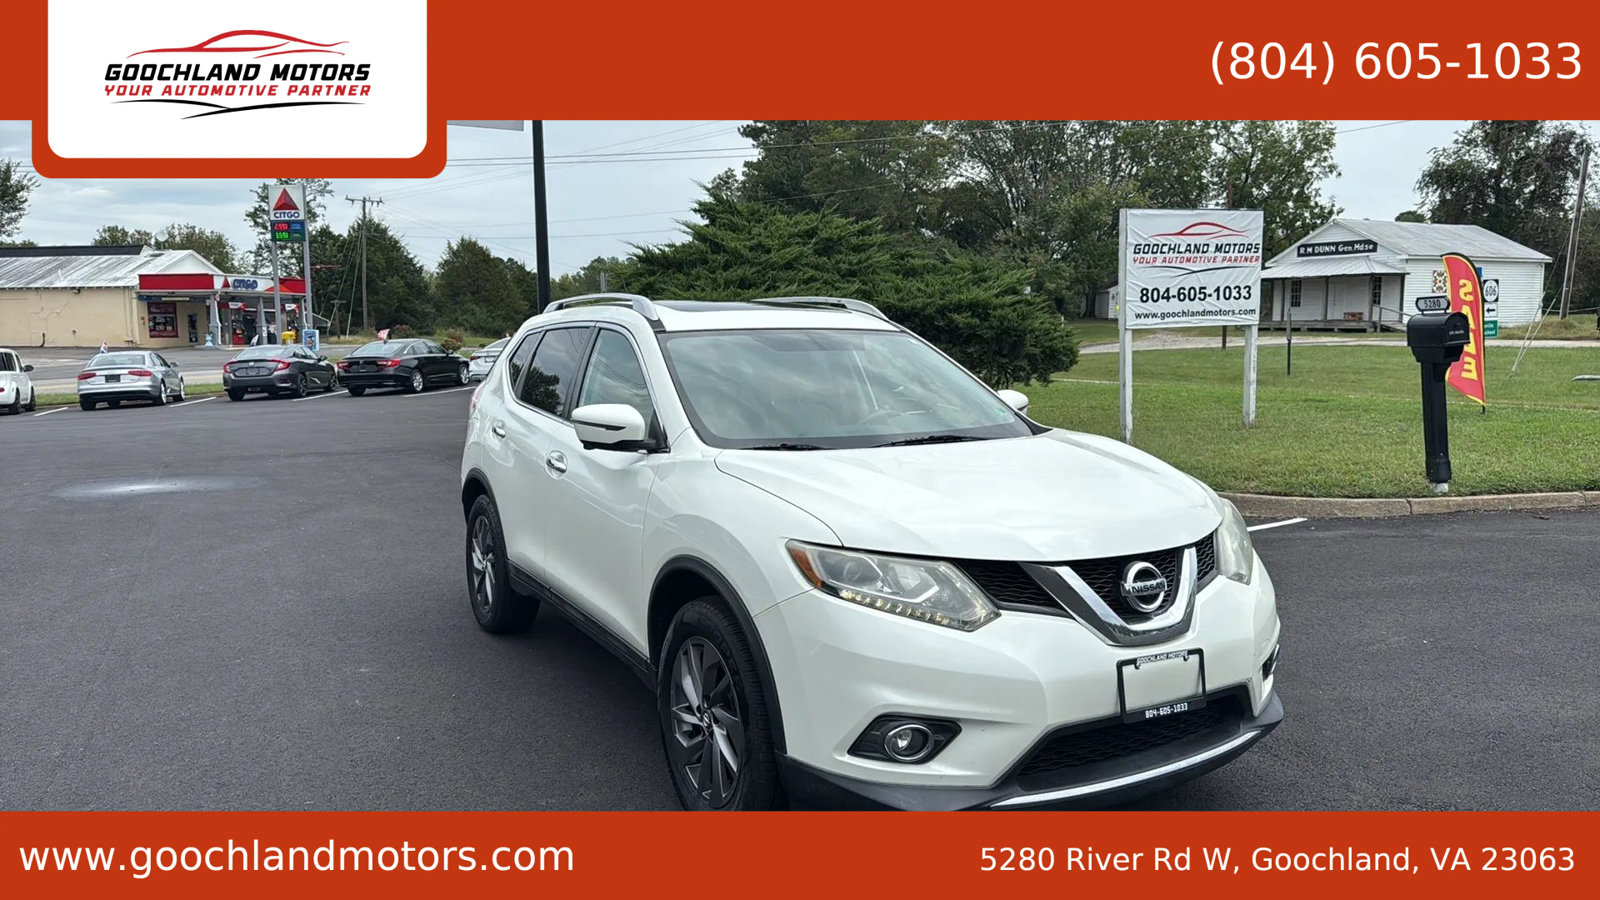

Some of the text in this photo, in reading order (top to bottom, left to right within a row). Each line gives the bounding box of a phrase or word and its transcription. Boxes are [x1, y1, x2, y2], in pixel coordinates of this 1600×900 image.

[273, 211, 300, 219] CITGO
[1133, 243, 1260, 255] GOOCHLAND MOTORS
[1314, 245, 1336, 254] DUNN
[1133, 255, 1260, 264] YOUR AUTOMOTIVE PARTNER
[232, 279, 258, 290] CITGO
[1140, 285, 1252, 303] 804-605-1033
[1485, 285, 1497, 297] 606
[1424, 297, 1441, 309] 5280
[1135, 308, 1256, 320] www.goochlandmotors.com
[1131, 580, 1165, 594] NISSAN
[1137, 650, 1188, 665] GOOCHLAND MOTORS
[1145, 703, 1188, 719] 804-605-1033
